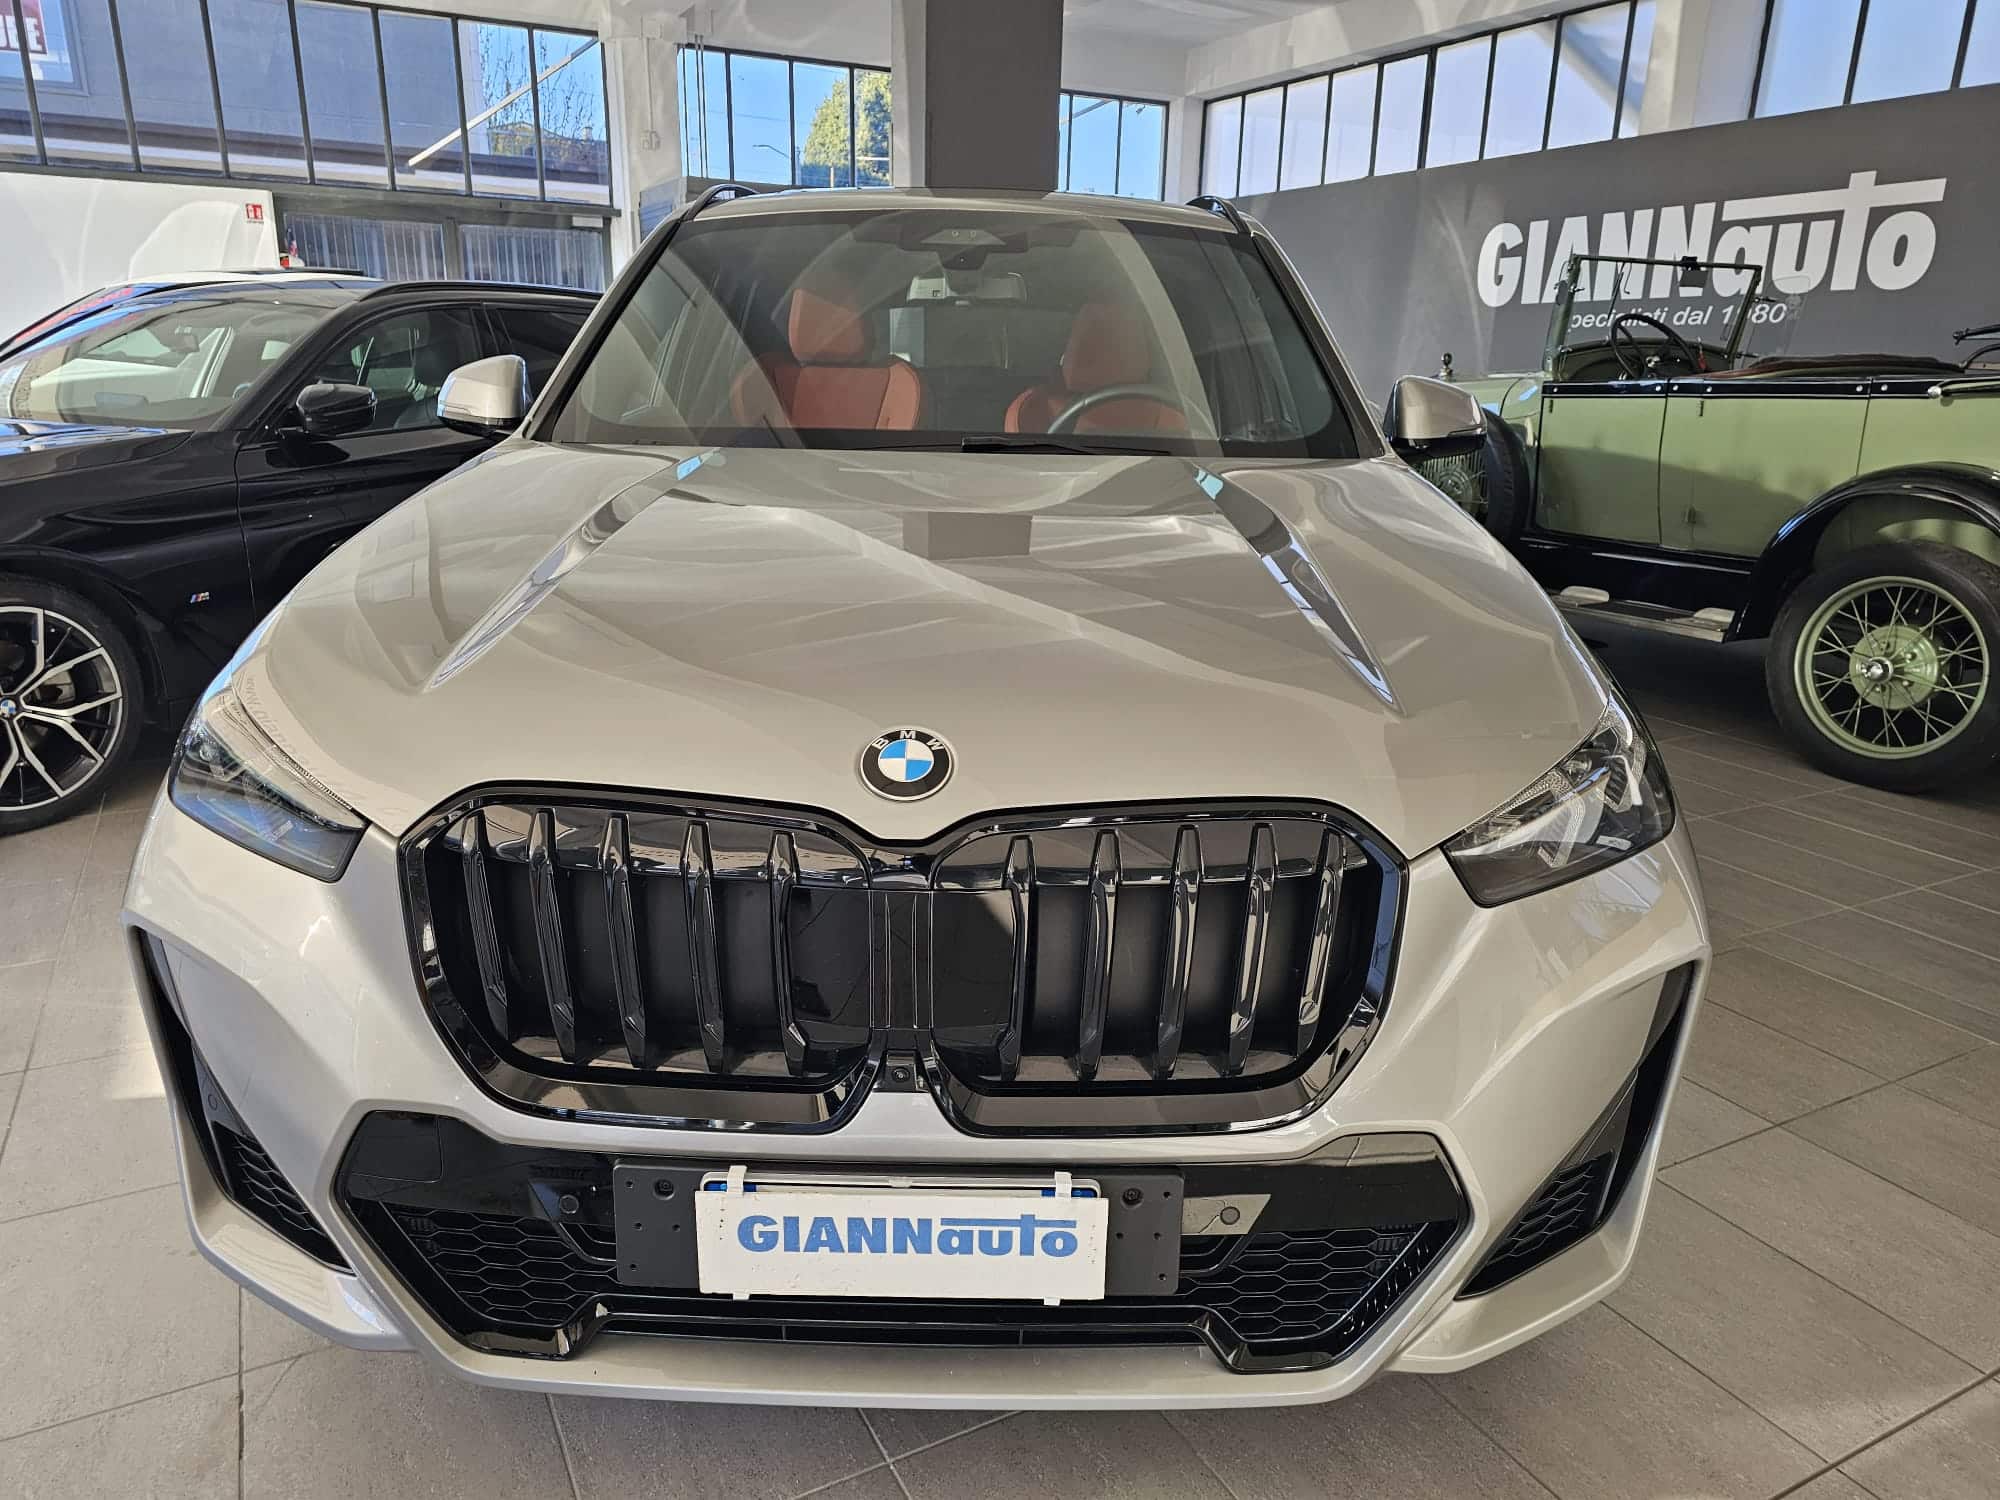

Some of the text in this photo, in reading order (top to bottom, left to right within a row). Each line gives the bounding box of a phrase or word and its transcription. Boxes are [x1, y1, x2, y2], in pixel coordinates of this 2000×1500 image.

[1672, 305, 1714, 327] dal
[1721, 302, 1788, 325] 180
[871, 730, 945, 751] BMW
[737, 1213, 1078, 1258] GIANNauto
